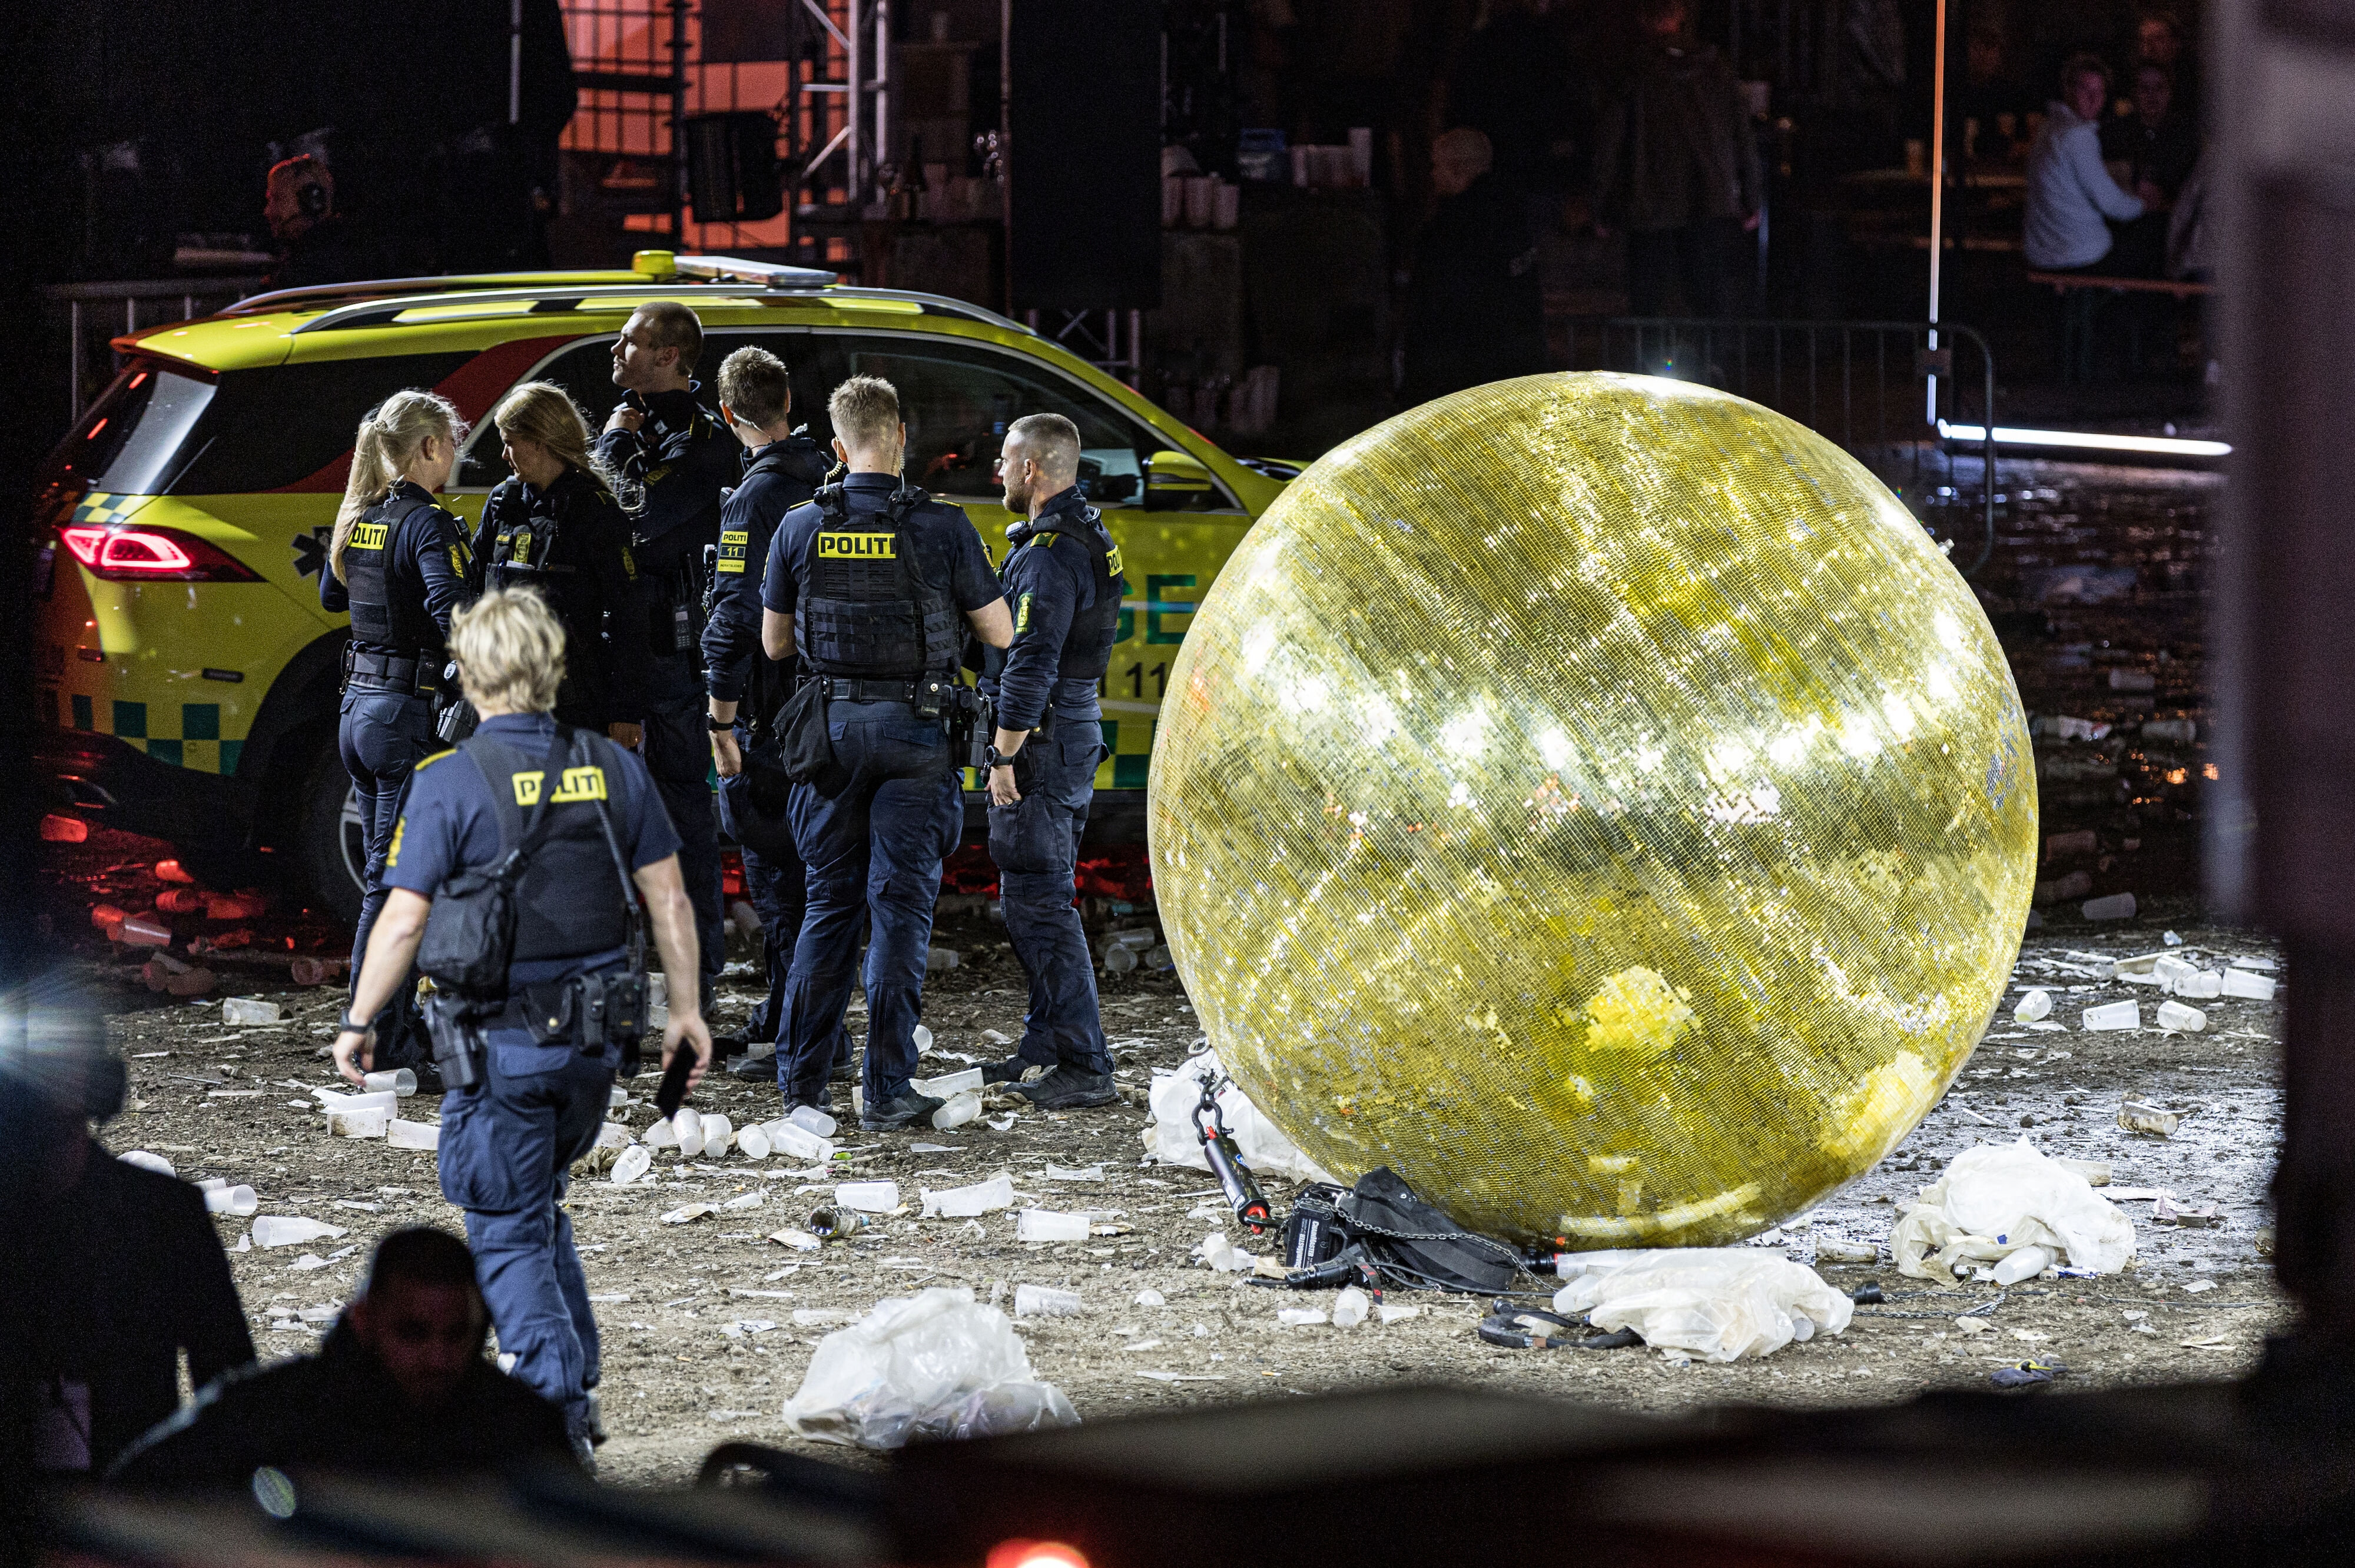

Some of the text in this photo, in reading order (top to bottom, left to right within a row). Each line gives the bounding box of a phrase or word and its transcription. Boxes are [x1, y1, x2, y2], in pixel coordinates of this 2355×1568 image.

[352, 526, 386, 545] OLITI
[727, 547, 738, 556] 11
[820, 536, 895, 554] POLITI
